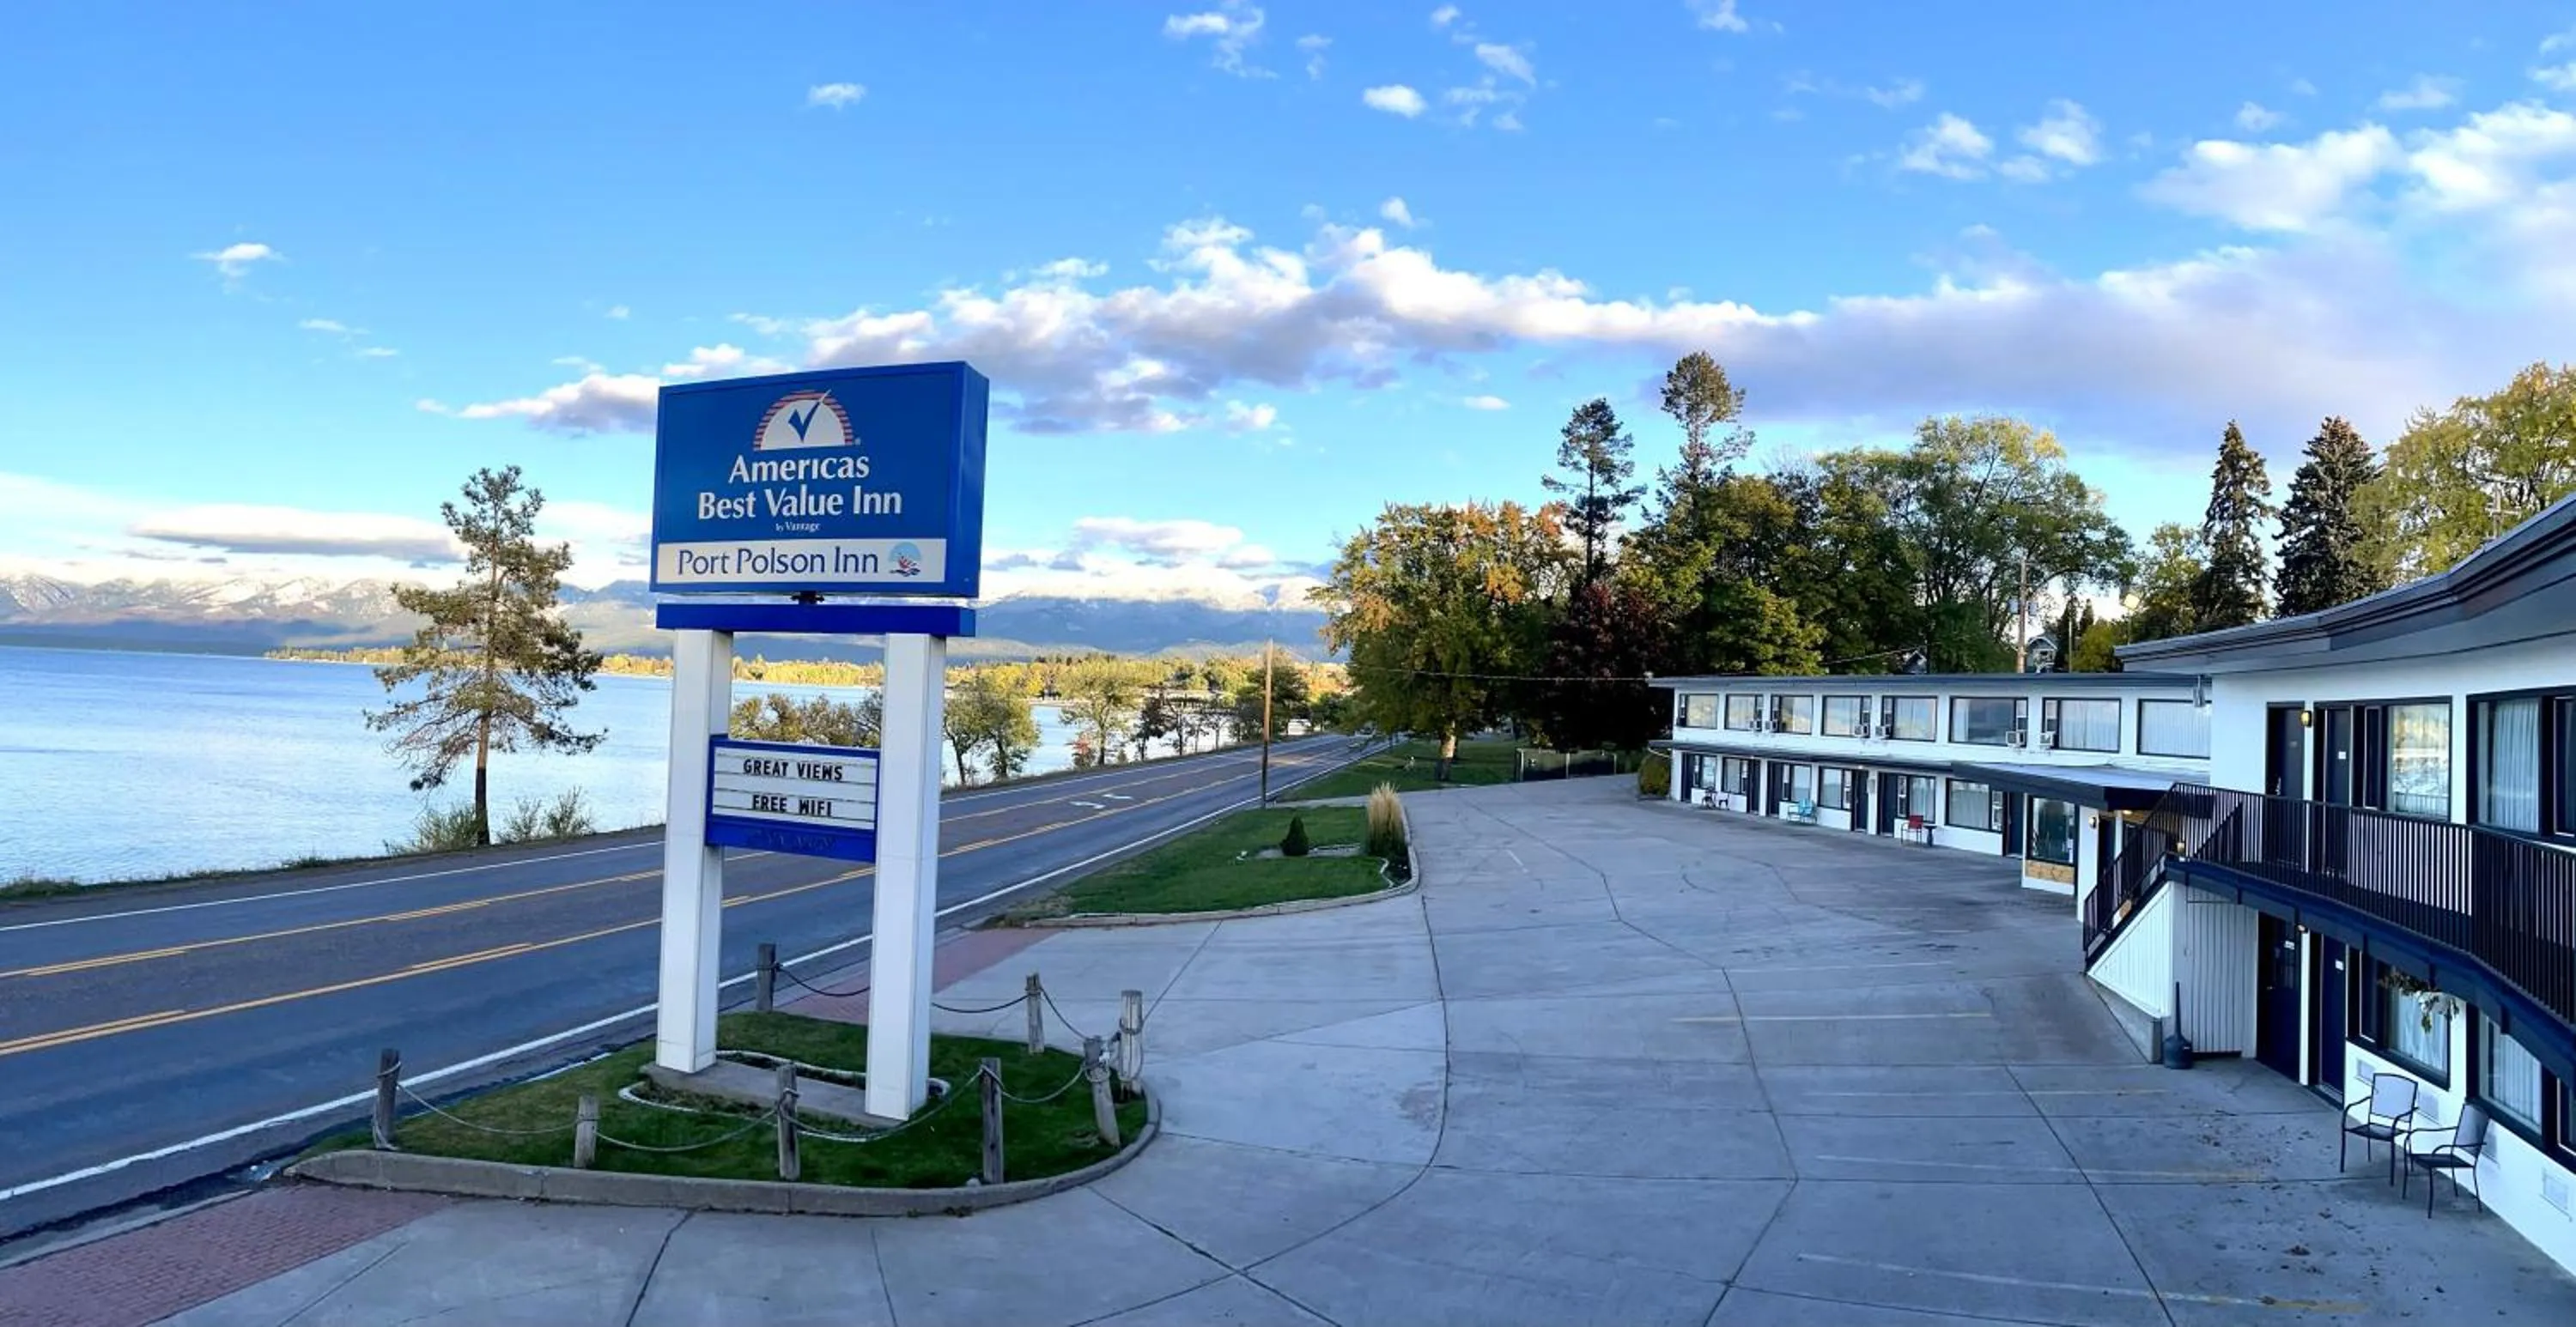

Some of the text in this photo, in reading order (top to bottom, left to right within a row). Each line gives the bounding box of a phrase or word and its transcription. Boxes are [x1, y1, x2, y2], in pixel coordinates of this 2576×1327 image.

[728, 454, 870, 483] Americas
[698, 483, 902, 520] Best Value Inn
[677, 546, 878, 575] Port Polson Inn
[744, 759, 842, 780] GREAT VIEWS
[752, 795, 832, 816] FREE WIFI
